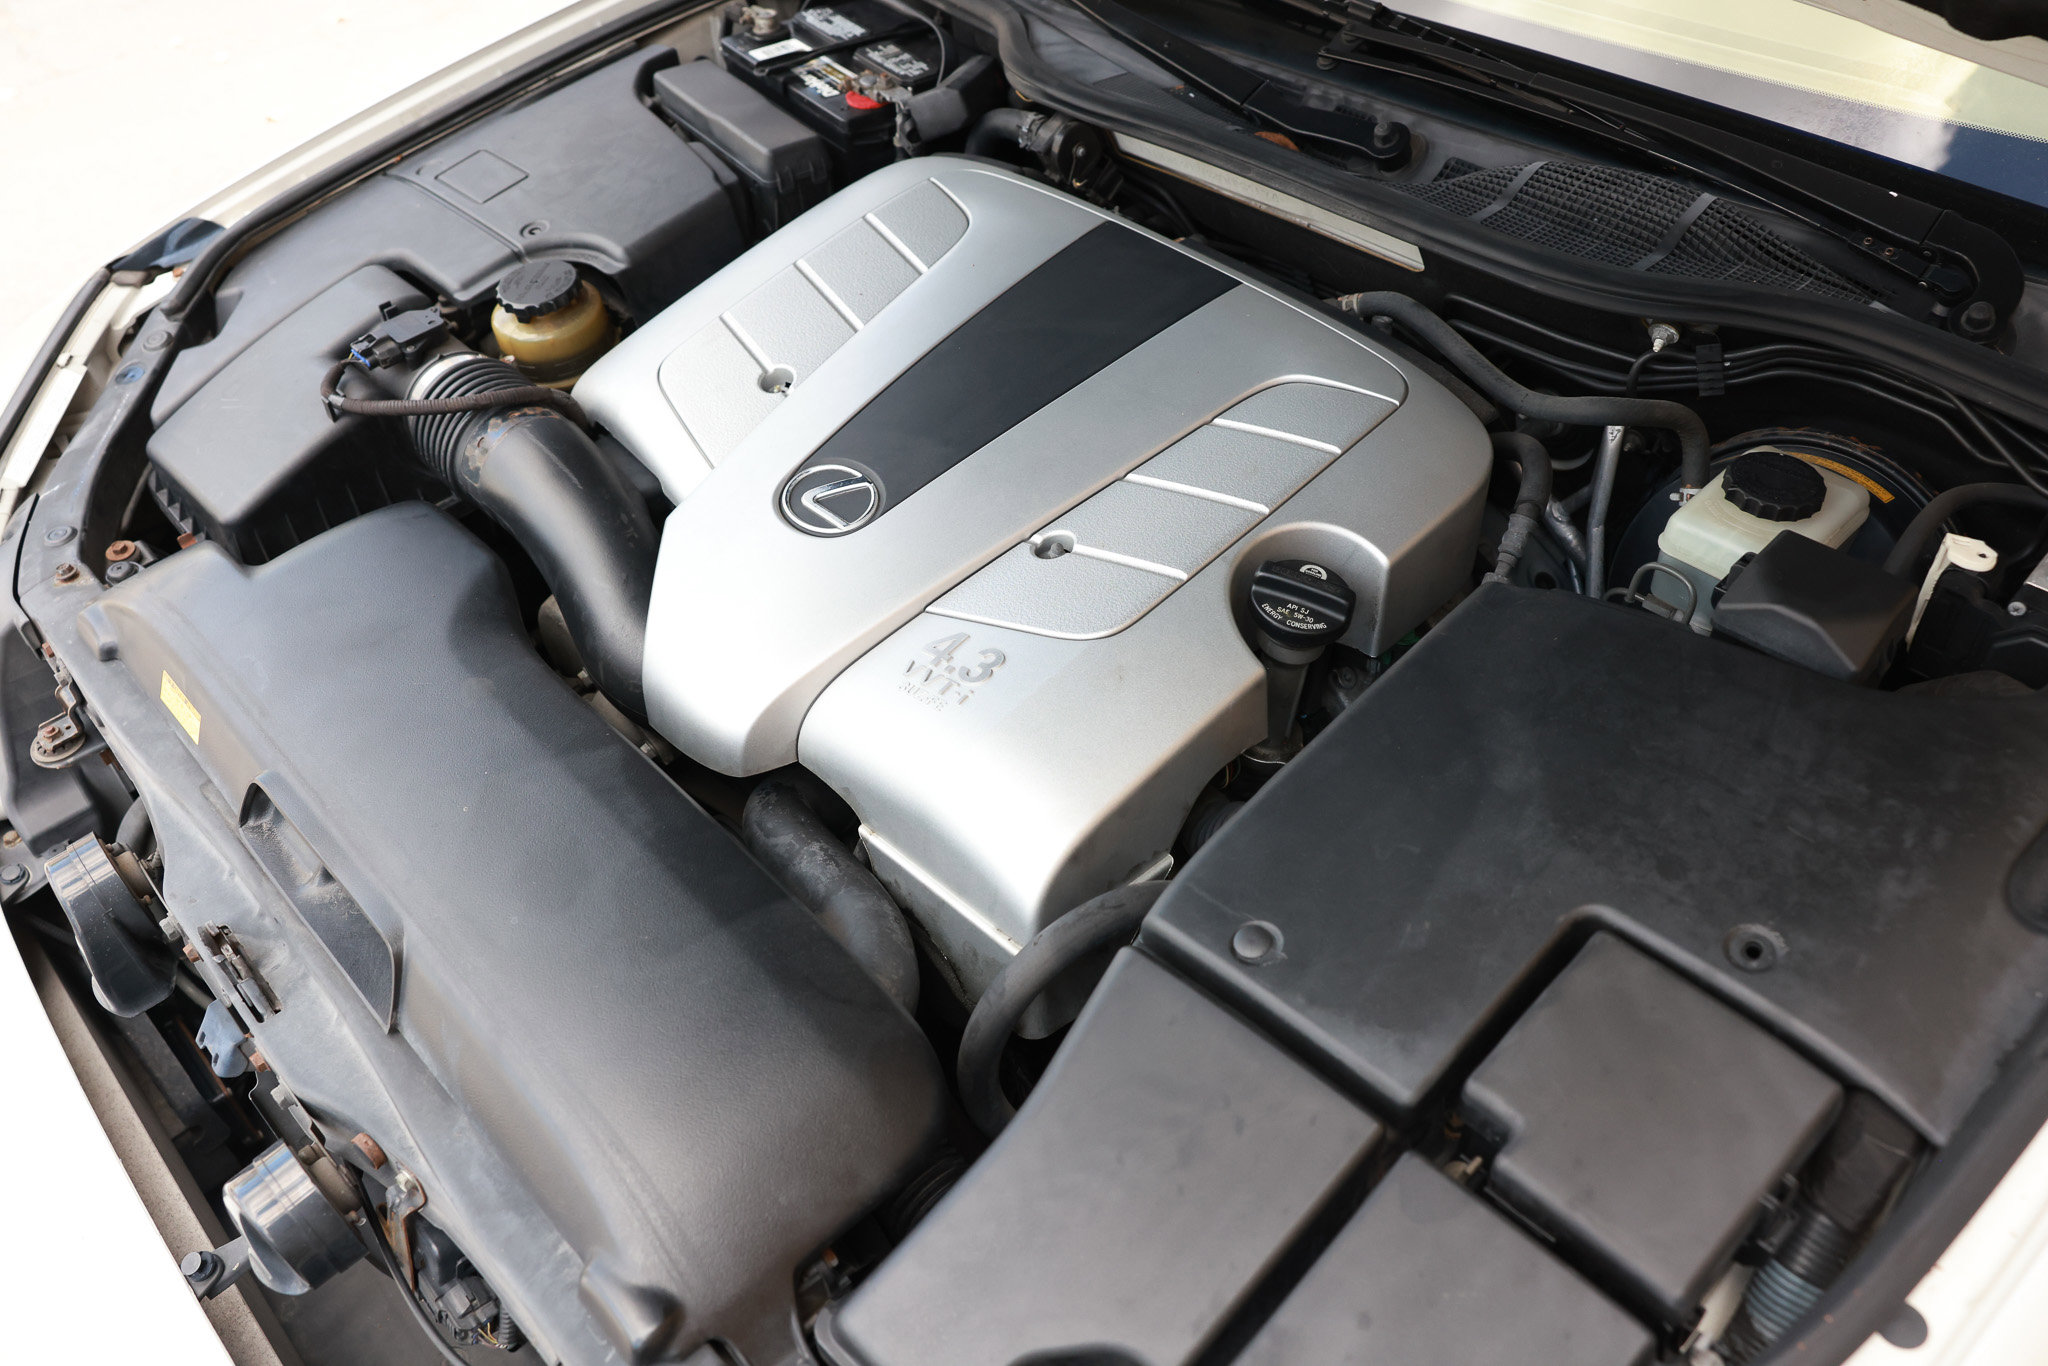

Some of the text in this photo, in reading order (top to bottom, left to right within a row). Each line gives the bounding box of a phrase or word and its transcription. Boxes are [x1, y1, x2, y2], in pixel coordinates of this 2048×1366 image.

[1261, 603, 1326, 629] ENERGY CONSERVING
[1276, 606, 1314, 624] SAE 5W-30
[1287, 603, 1310, 615] API SJ
[921, 632, 1006, 685] 4.3
